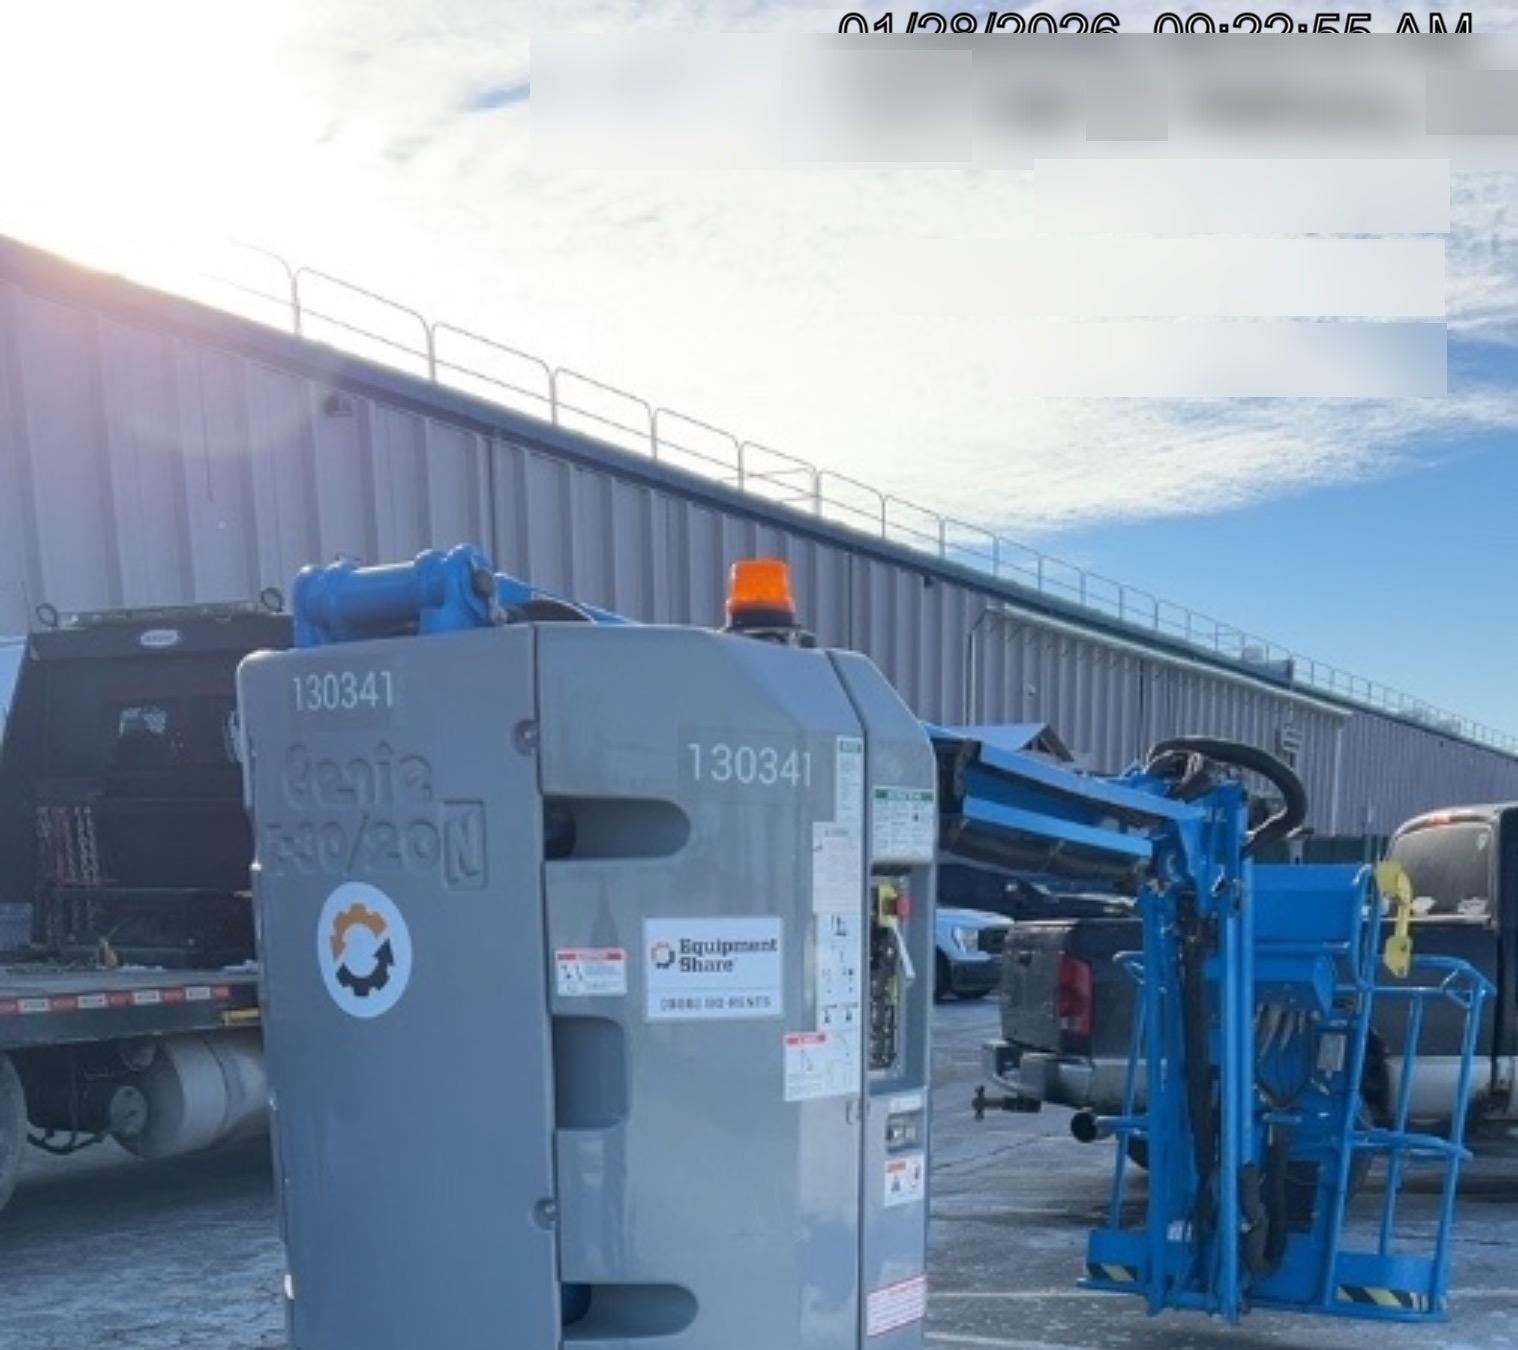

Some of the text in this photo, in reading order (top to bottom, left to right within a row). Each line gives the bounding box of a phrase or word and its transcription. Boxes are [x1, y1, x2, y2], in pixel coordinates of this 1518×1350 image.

[293, 671, 394, 711] 130341
[284, 740, 433, 808] Genie
[688, 743, 811, 788] 130341
[679, 938, 778, 957] Equipment
[679, 957, 734, 973] Share
